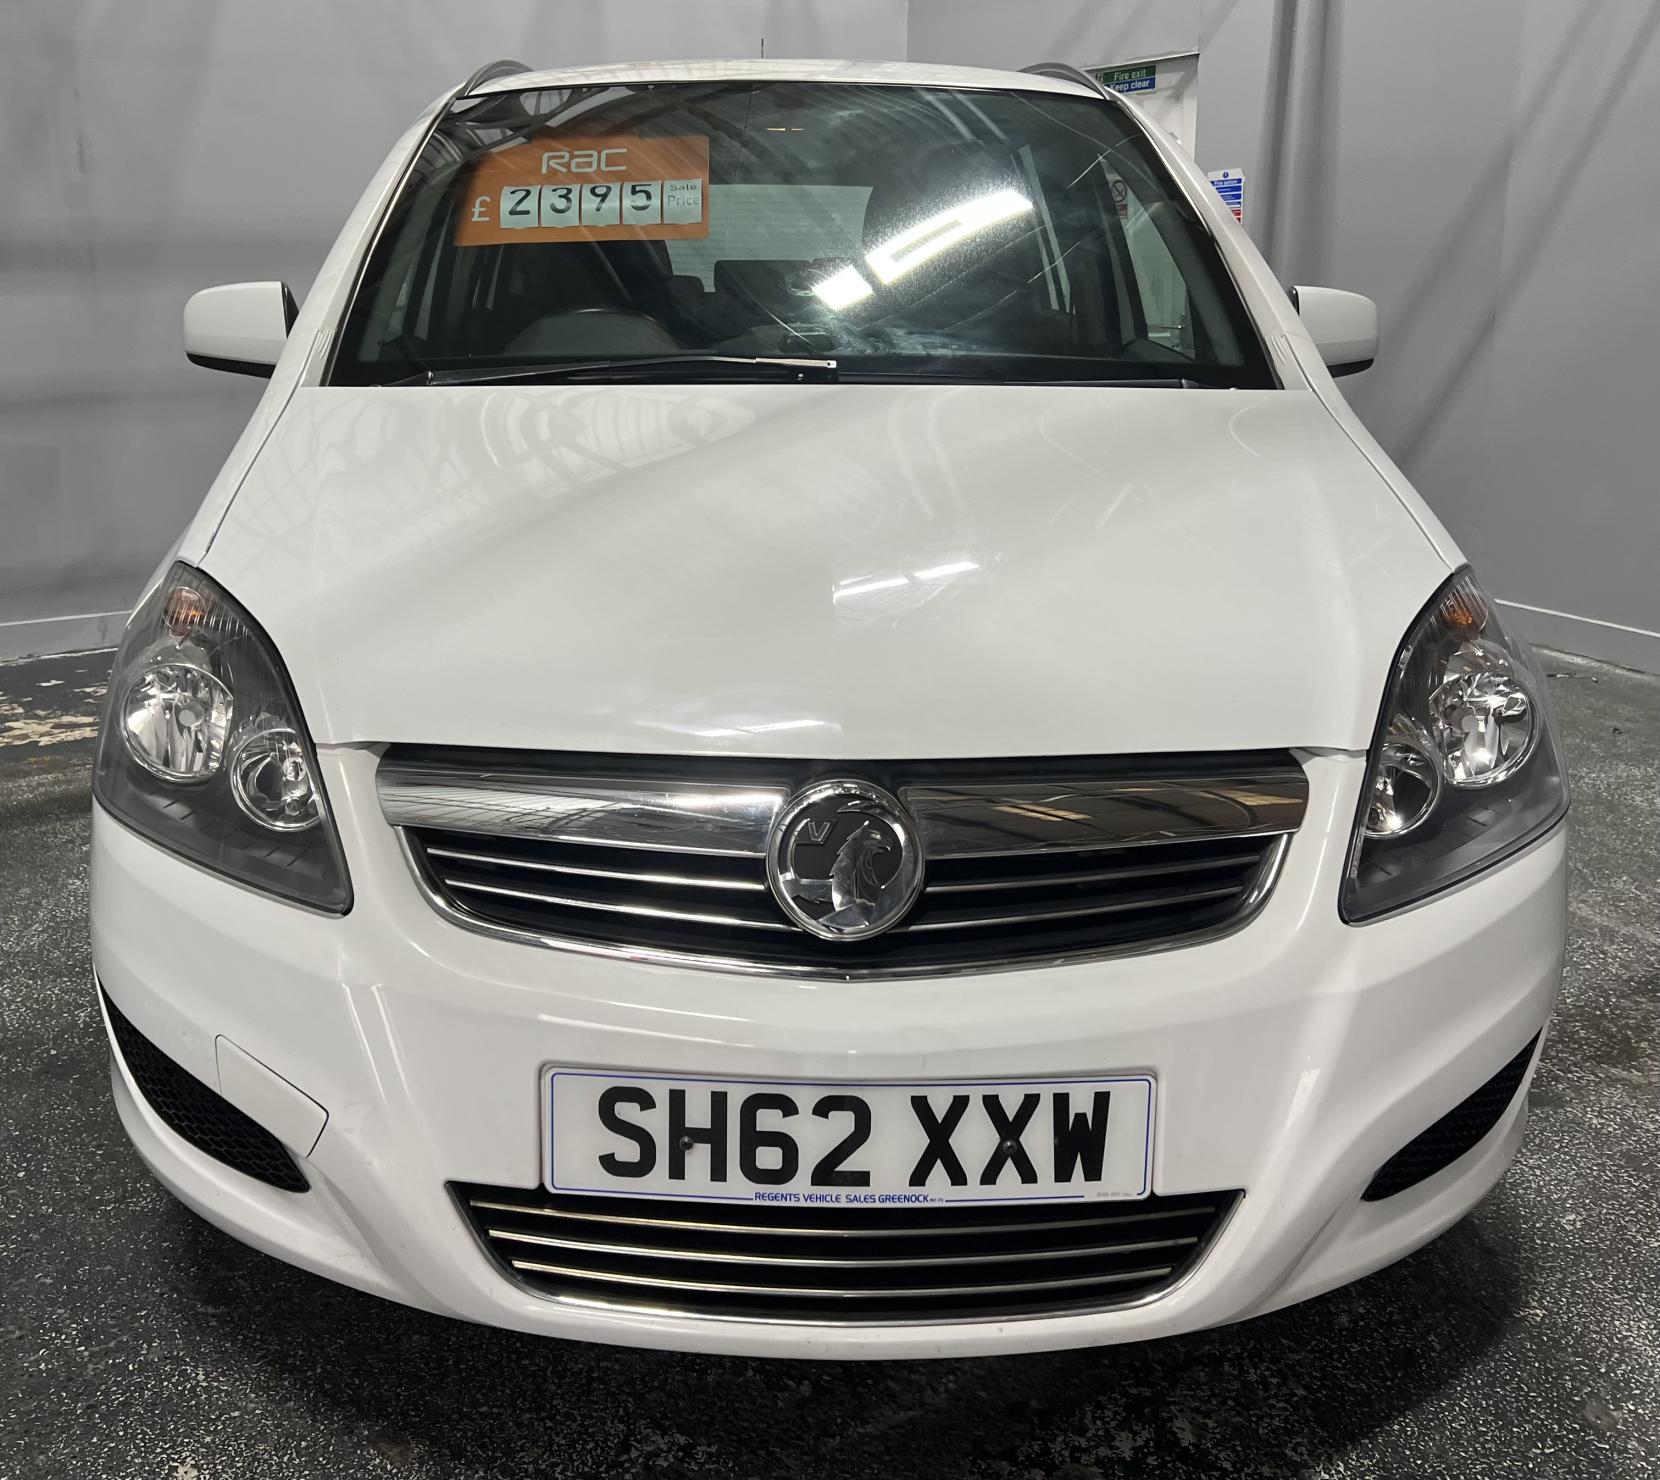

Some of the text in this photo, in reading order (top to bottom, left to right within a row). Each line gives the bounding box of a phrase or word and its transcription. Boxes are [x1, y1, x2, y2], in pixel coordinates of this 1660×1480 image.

[1114, 69, 1146, 80] Fire exit
[1130, 80, 1150, 88] clear
[670, 183, 697, 191] Sale
[667, 194, 700, 206] Price
[598, 1086, 1111, 1187] SH62 XXW
[754, 1192, 800, 1202] REGENTS
[802, 1194, 841, 1203] VEHICLE
[845, 1195, 876, 1203] SALES
[878, 1194, 929, 1204] GREENOCK
